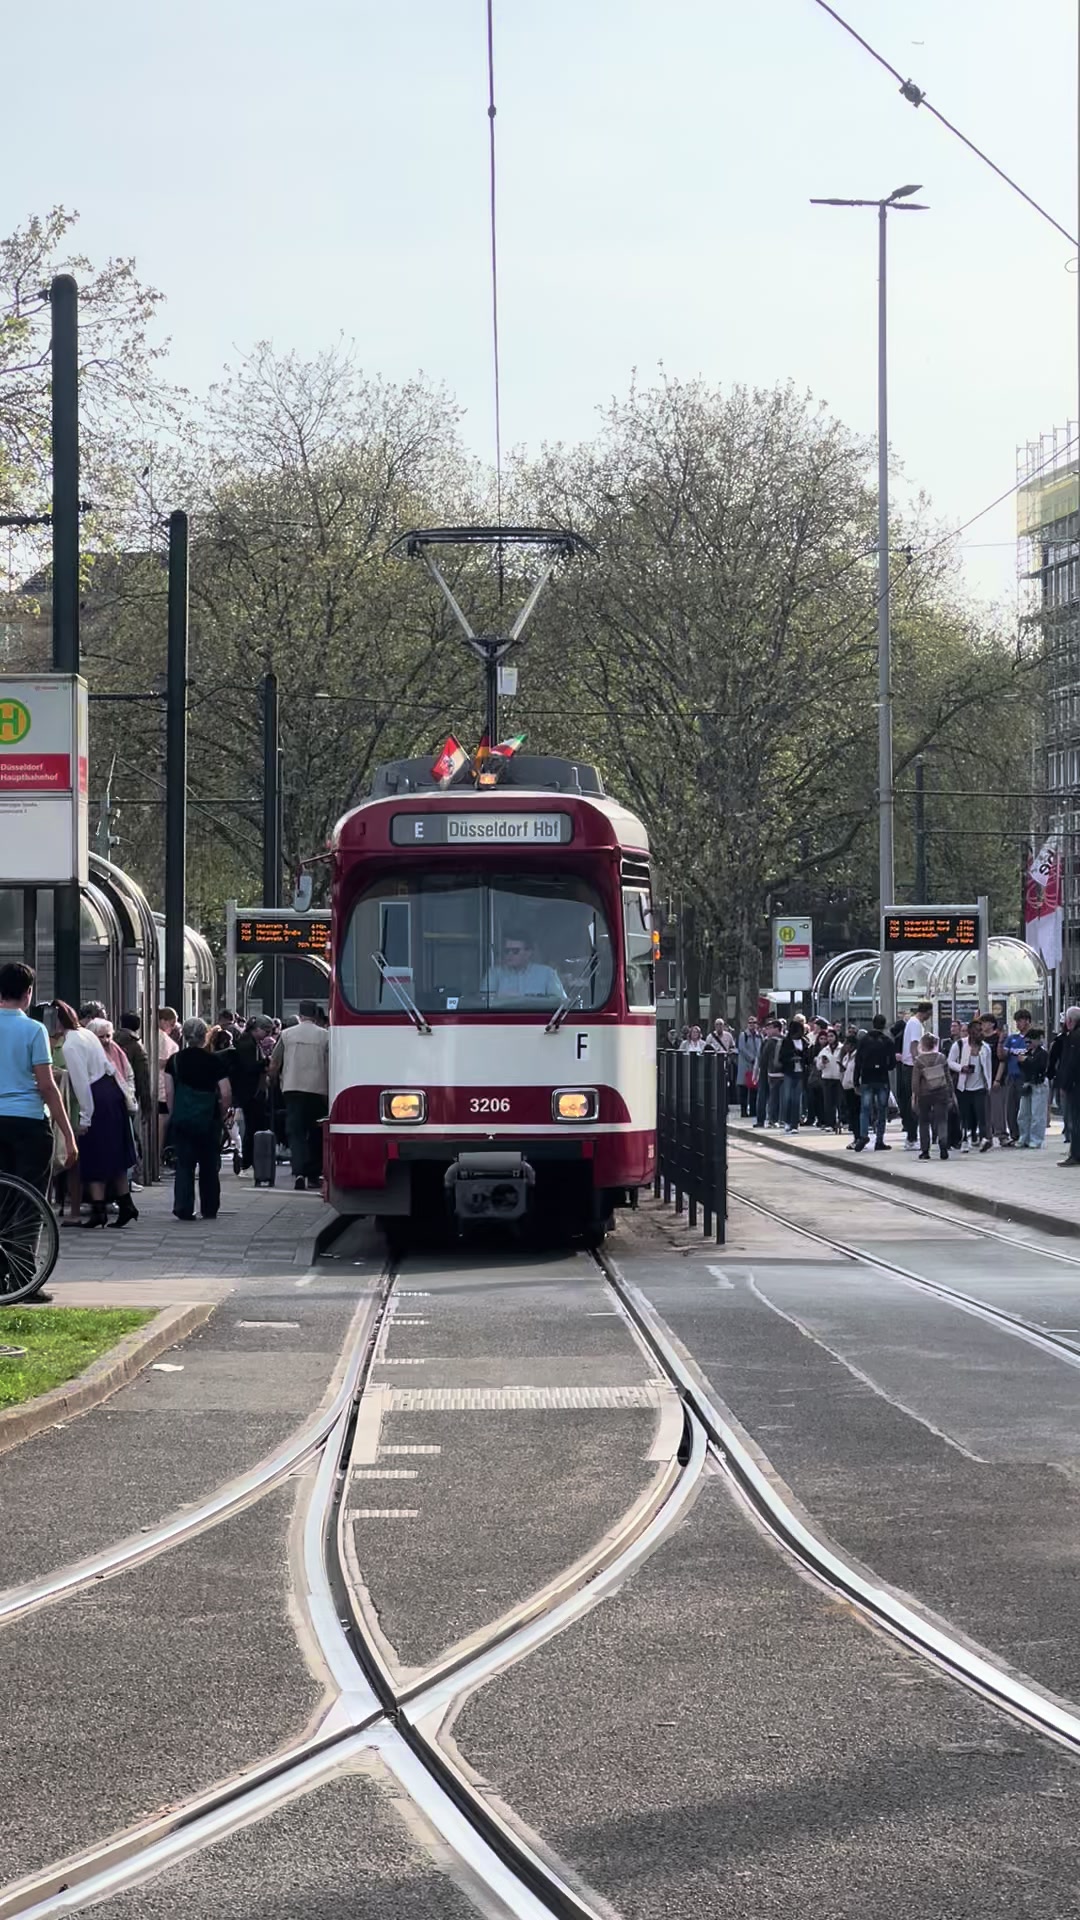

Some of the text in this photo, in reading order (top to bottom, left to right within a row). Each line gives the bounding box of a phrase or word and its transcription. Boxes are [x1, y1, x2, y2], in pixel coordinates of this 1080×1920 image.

[0, 762, 43, 771] Düsseldorf
[0, 772, 58, 782] Hauptbahnhof
[414, 822, 424, 838] E
[450, 821, 559, 837] Düsseldorf Hbf
[577, 1033, 588, 1060] F
[469, 1098, 511, 1112] 3206
